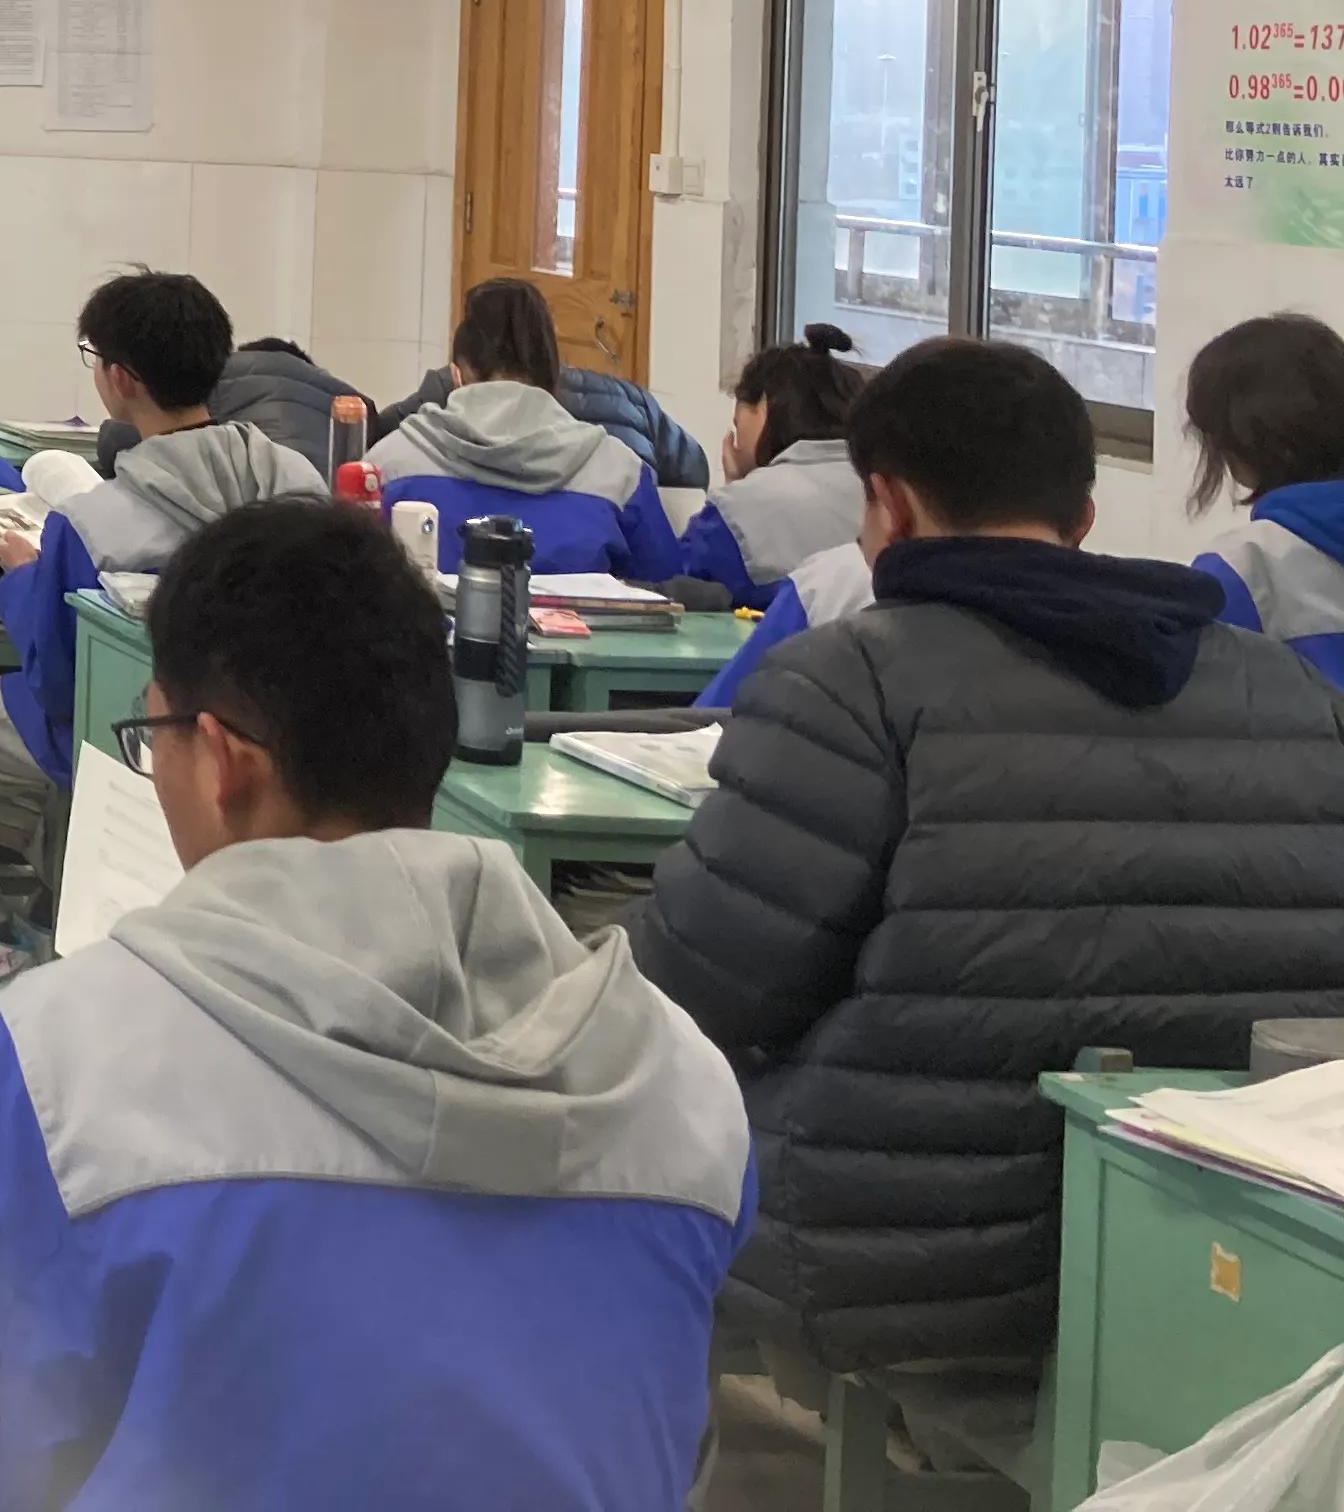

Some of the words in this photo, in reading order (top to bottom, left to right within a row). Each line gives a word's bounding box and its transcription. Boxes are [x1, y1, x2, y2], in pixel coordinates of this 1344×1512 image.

[1224, 148, 1344, 168] 比你努力一点的人，其实
